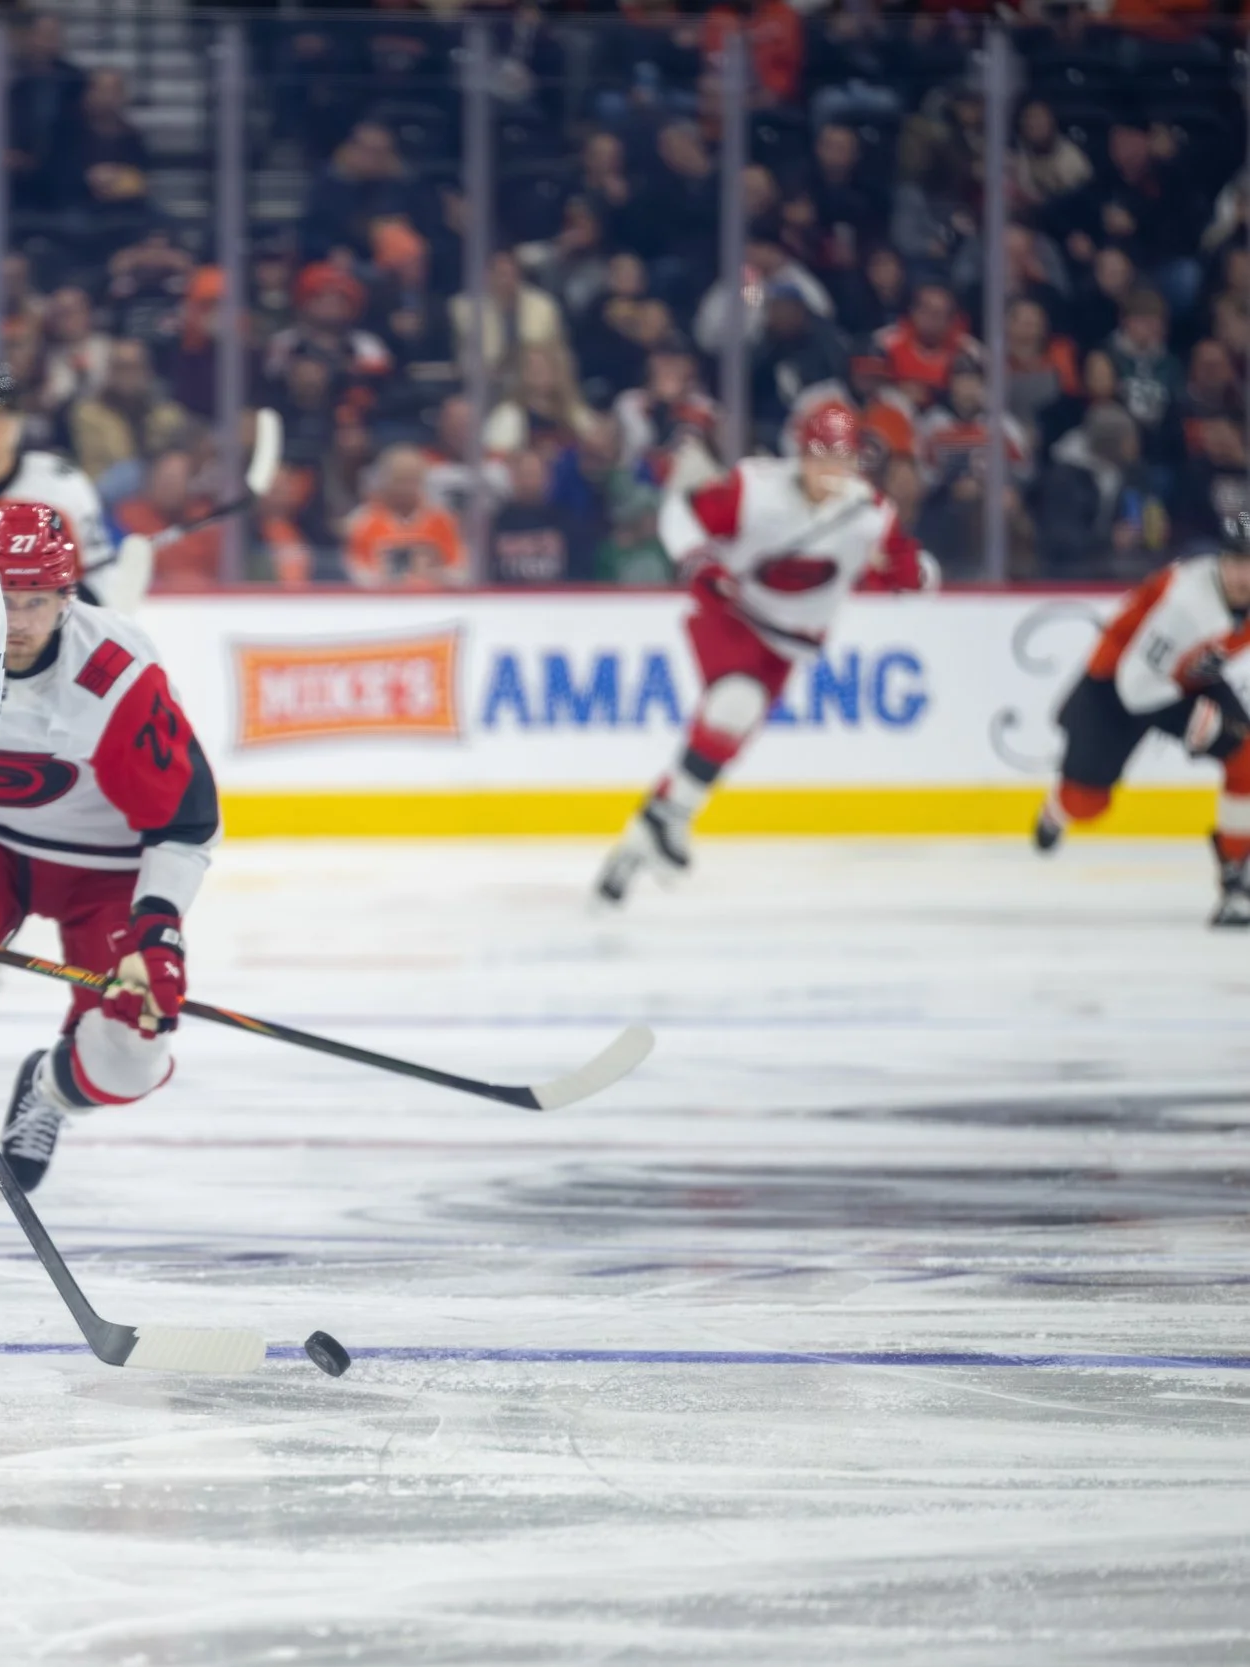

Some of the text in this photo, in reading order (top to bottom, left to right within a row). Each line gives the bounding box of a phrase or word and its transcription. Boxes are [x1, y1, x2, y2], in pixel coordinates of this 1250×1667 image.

[9, 534, 38, 554] 27
[483, 651, 928, 727] AMANG
[134, 690, 179, 771] 27
